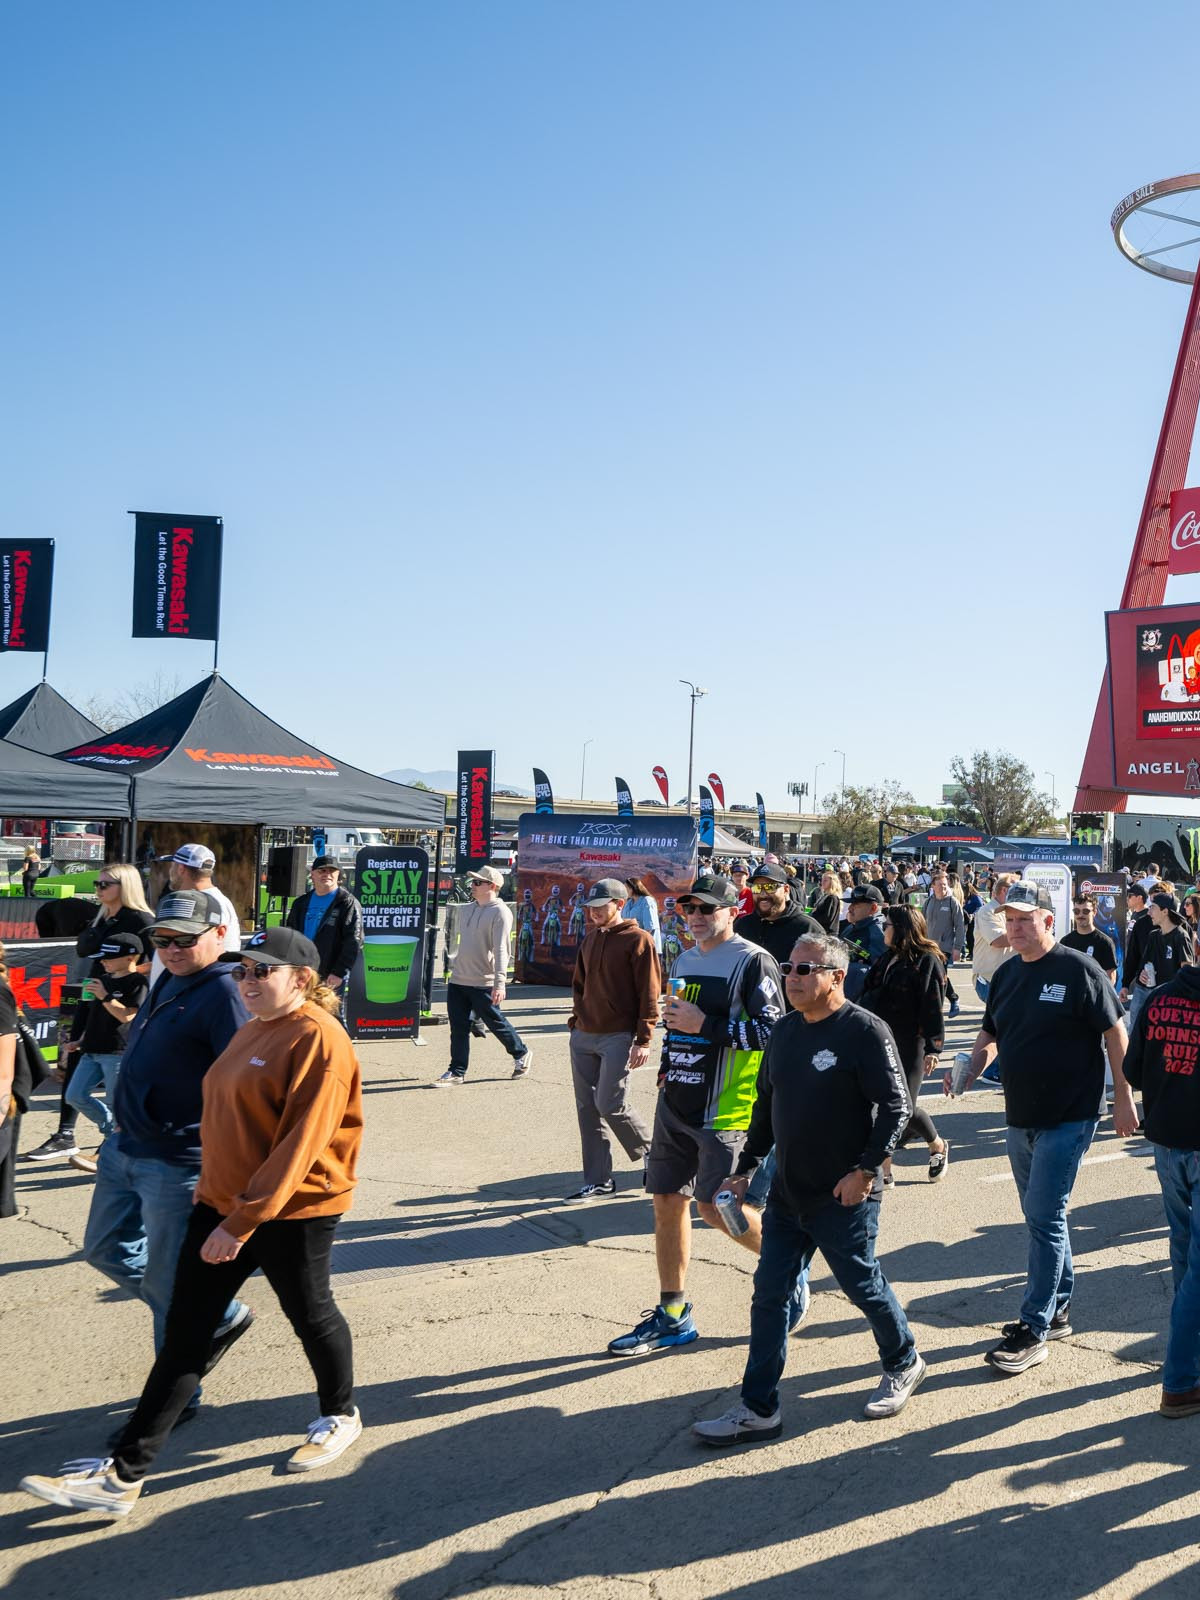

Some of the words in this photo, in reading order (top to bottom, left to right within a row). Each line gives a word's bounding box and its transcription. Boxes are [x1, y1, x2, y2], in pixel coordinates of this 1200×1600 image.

[1135, 183, 1155, 201] SALE
[158, 531, 168, 545] Let
[158, 547, 168, 561] the
[158, 562, 167, 585] Good
[168, 528, 194, 634] Kawasaki
[3, 583, 11, 604] Good
[8, 550, 32, 647] Kawasaki
[157, 586, 167, 611] Times
[184, 748, 336, 770] Kawasaki
[250, 766, 283, 774] Good
[284, 767, 316, 776] Times
[1127, 762, 1185, 775] ANGEL
[460, 798, 468, 818] Good
[470, 767, 489, 858] Kawasaki
[460, 818, 468, 838] Times
[531, 834, 545, 844] THE
[548, 835, 567, 845] BIKE
[570, 836, 590, 846] THAT
[593, 837, 623, 847] BUILDS
[626, 838, 679, 848] CHAMPIONS
[367, 859, 407, 870] Register
[409, 860, 419, 869] to
[579, 852, 621, 862] Kawasaki
[361, 870, 423, 894] STAY
[361, 894, 421, 905] CONNECTED
[362, 905, 377, 915] and
[380, 905, 412, 915] receive
[414, 907, 421, 915] a
[362, 915, 390, 928] FREE
[392, 915, 421, 928] GIFT
[669, 1051, 706, 1065] FLY
[1163, 1042, 1199, 1061] RUIZ
[1164, 1058, 1196, 1076] 2025
